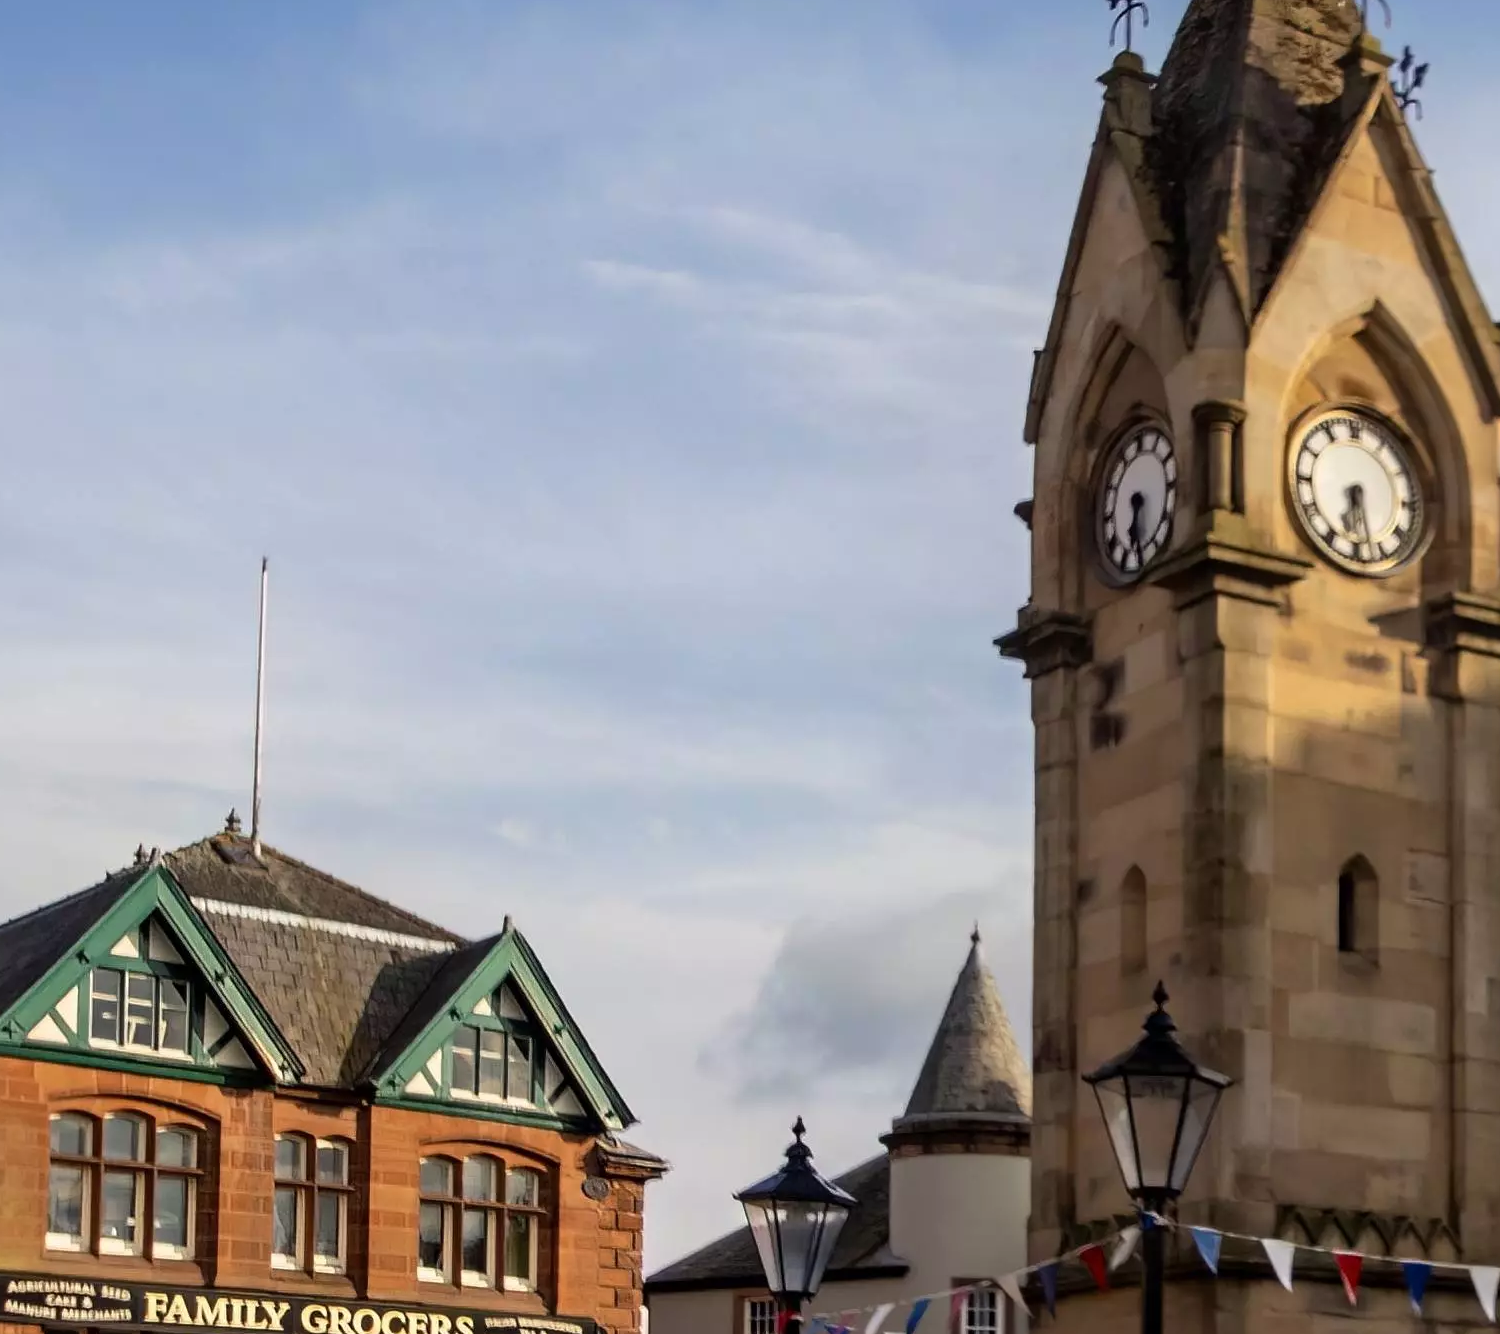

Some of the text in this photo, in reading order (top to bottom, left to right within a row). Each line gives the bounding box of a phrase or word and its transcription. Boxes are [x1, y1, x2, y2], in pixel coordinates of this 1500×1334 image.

[7, 1280, 131, 1301] AGRICULTURAL SEED
[45, 1294, 77, 1307] CAKE
[4, 1299, 132, 1322] MANURE MERCHANTS
[143, 1291, 291, 1331] FAMILY
